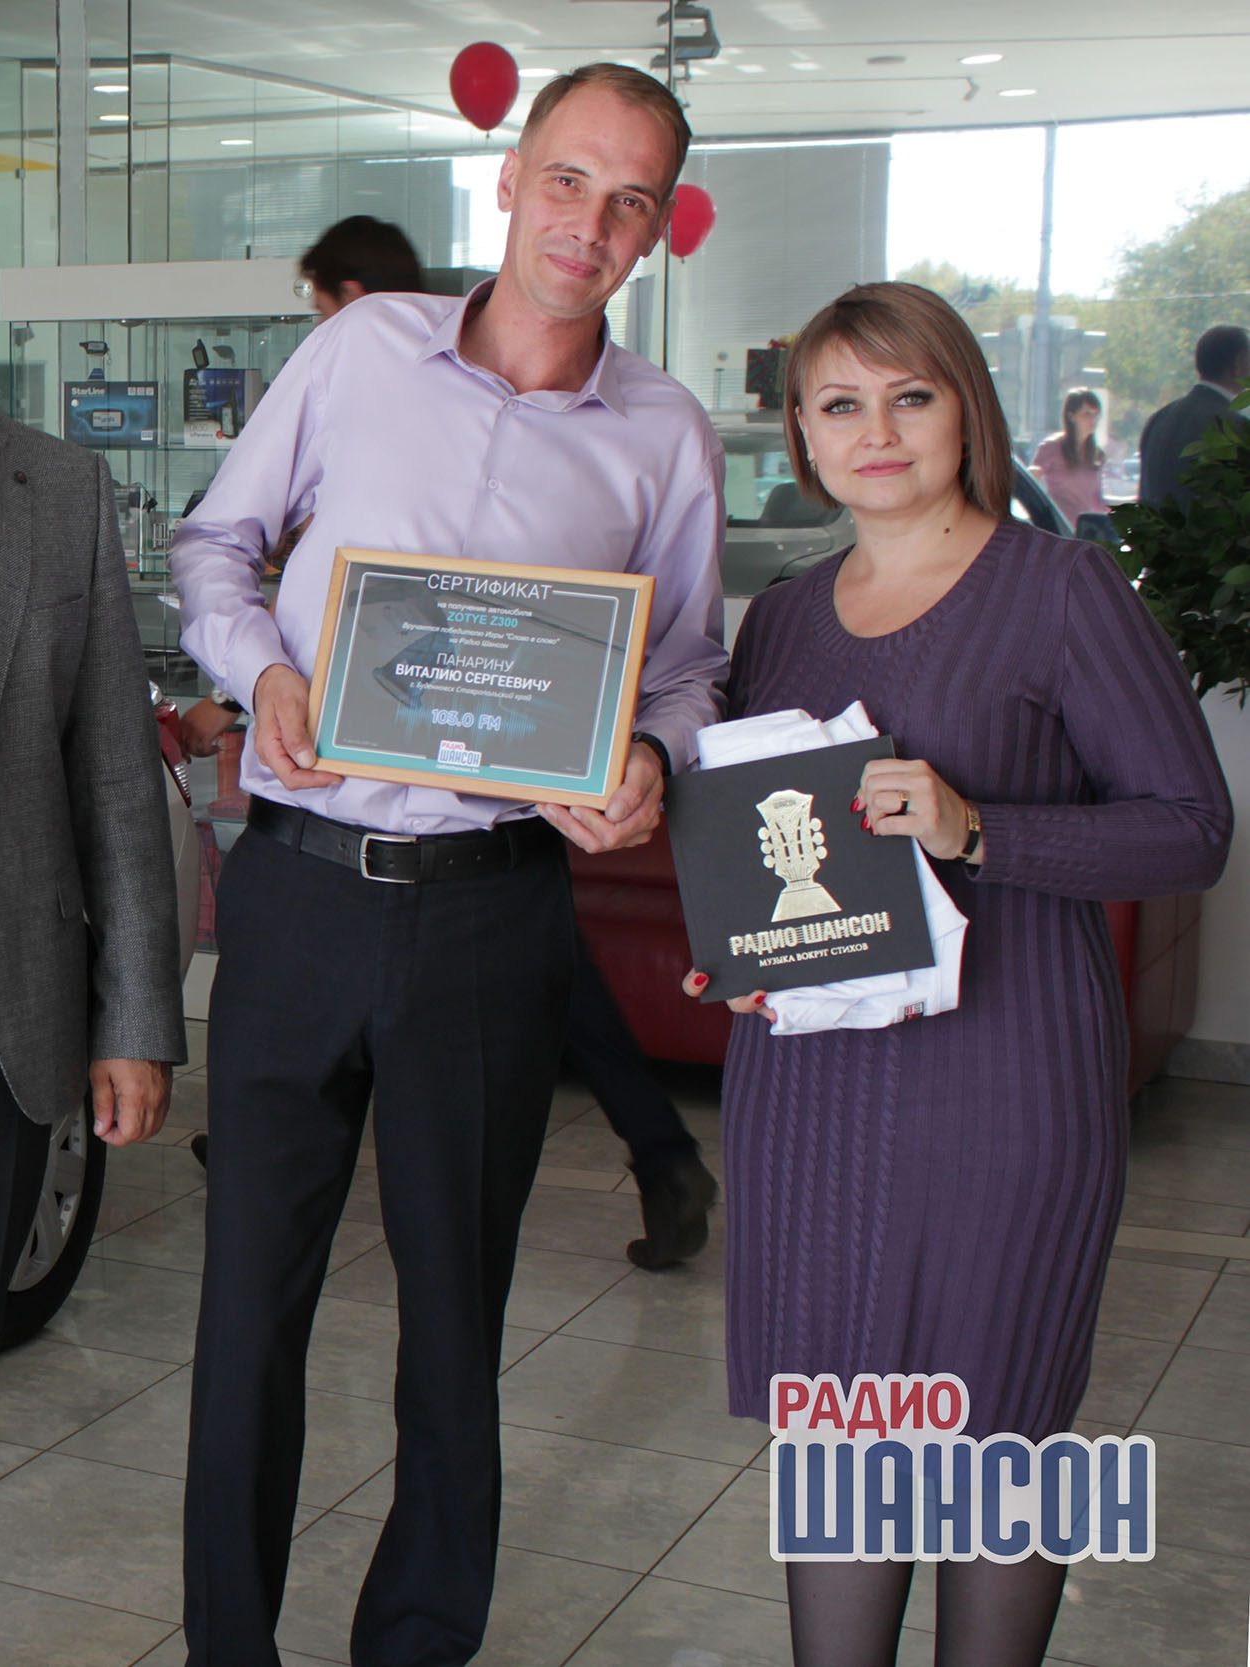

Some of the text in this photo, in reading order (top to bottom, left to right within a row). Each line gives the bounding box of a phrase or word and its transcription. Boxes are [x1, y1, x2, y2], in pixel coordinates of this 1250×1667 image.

[427, 573, 553, 600] СЕРТИФИКАТ
[447, 610, 519, 629] ZOTYE Z300
[448, 603, 487, 613] получение
[488, 607, 533, 617] автомобиля
[459, 637, 481, 646] Радио
[481, 640, 510, 649] Шансон
[436, 652, 514, 673] ПАНАРИНУ
[395, 663, 552, 692] ВИТАЛИЮ СЕРГЕЕВИЧУ
[478, 714, 502, 732] FM
[441, 741, 464, 751] РАДИО
[439, 750, 480, 767] ШАНСОН
[729, 911, 891, 956] РАДИО ШАНСОН
[759, 942, 869, 967] МУЗЫКА ВОКРУГ СТИХОВ
